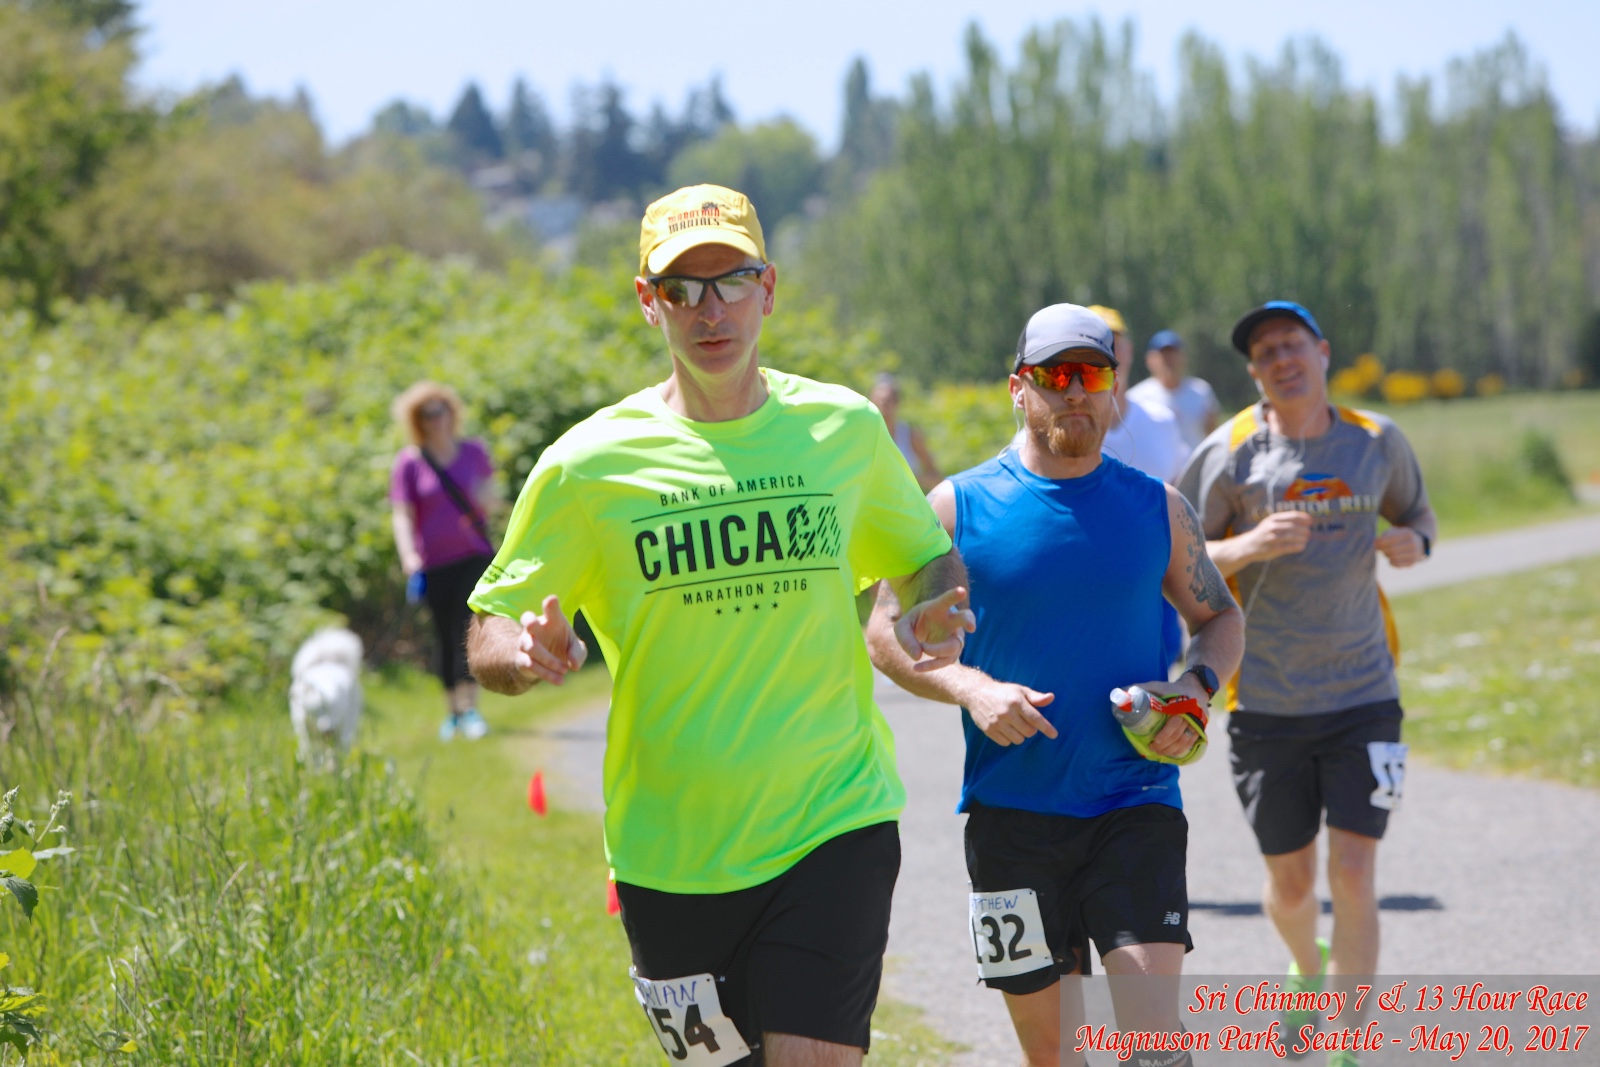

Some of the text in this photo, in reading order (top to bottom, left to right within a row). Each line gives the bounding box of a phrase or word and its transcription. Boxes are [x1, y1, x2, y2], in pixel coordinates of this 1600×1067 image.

[660, 475, 805, 506] BANK OF AMERICA
[634, 502, 841, 582] CHICAGO
[683, 578, 807, 606] MARATHON 2016
[643, 1003, 721, 1061] 54
